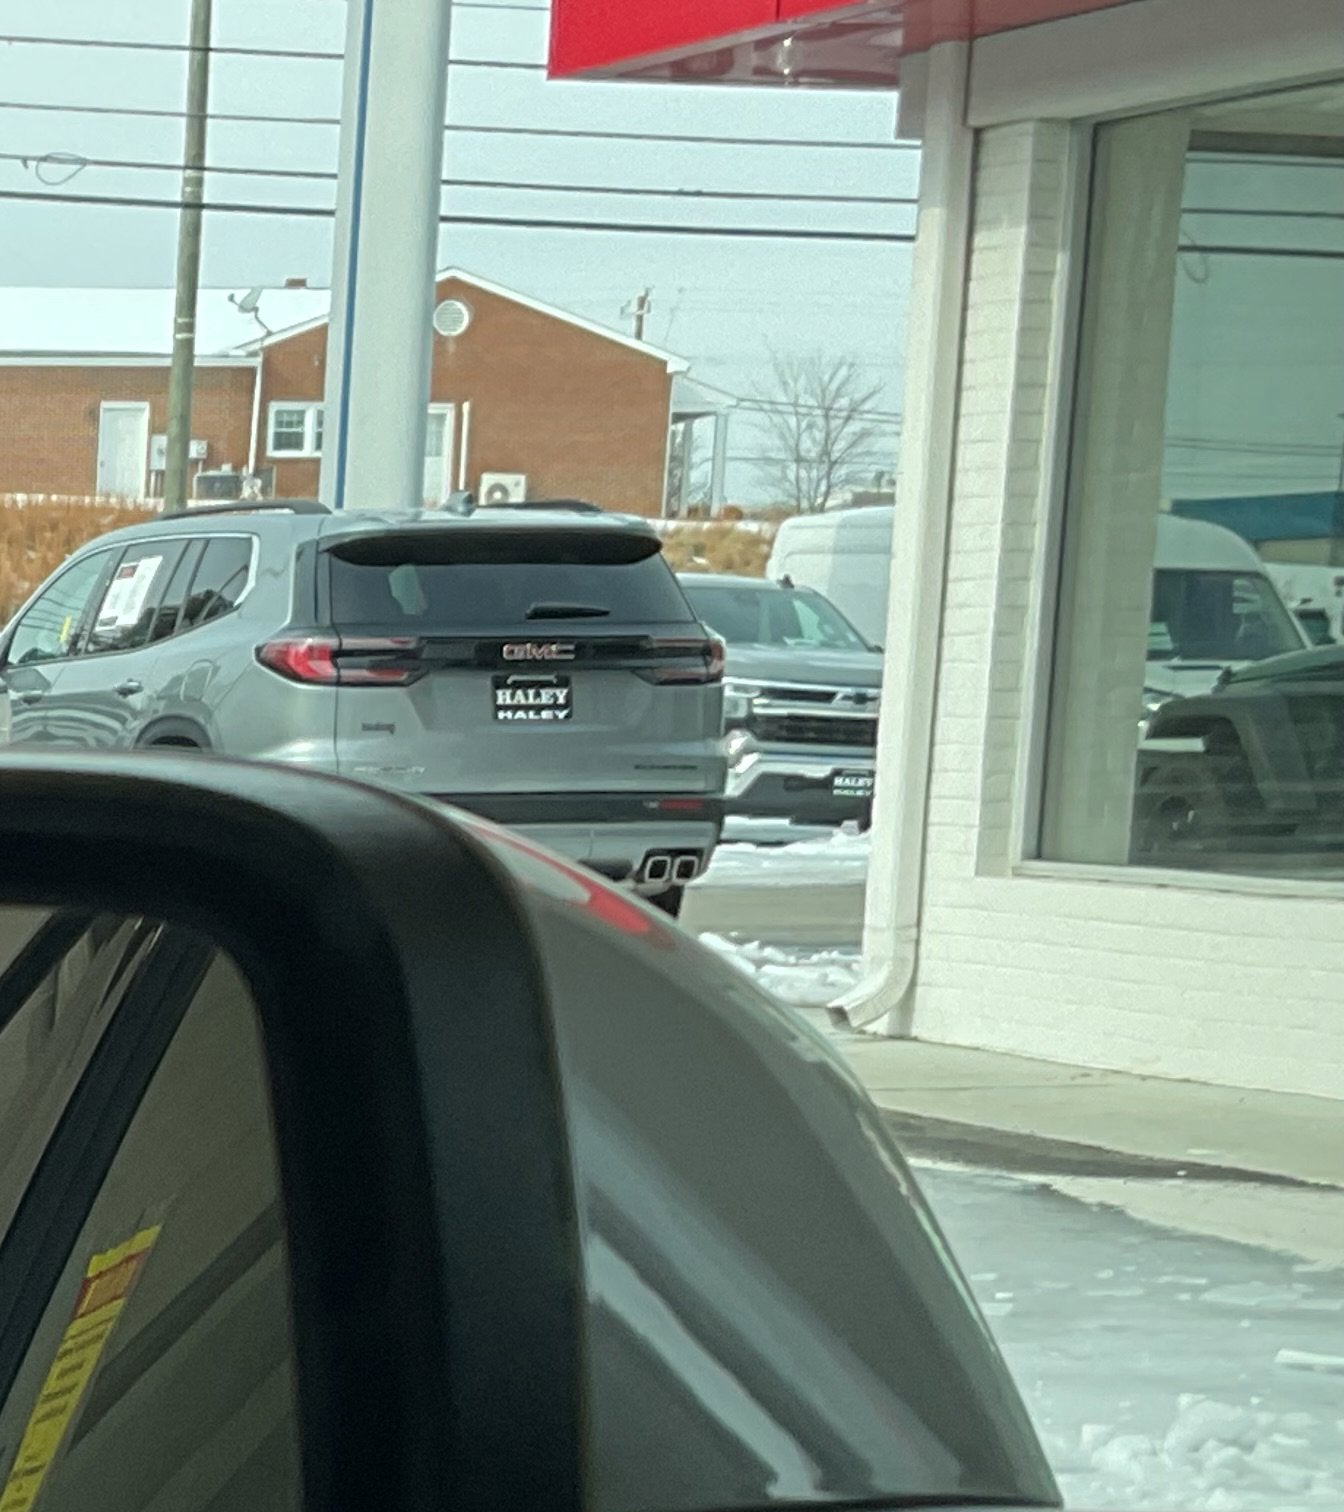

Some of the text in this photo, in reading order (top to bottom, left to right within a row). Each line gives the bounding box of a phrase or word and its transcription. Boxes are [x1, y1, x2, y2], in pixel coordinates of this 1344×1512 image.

[502, 642, 575, 660] GMC
[495, 688, 569, 705] HALEY
[497, 709, 570, 720] HALEY
[834, 775, 873, 787] HALEY
